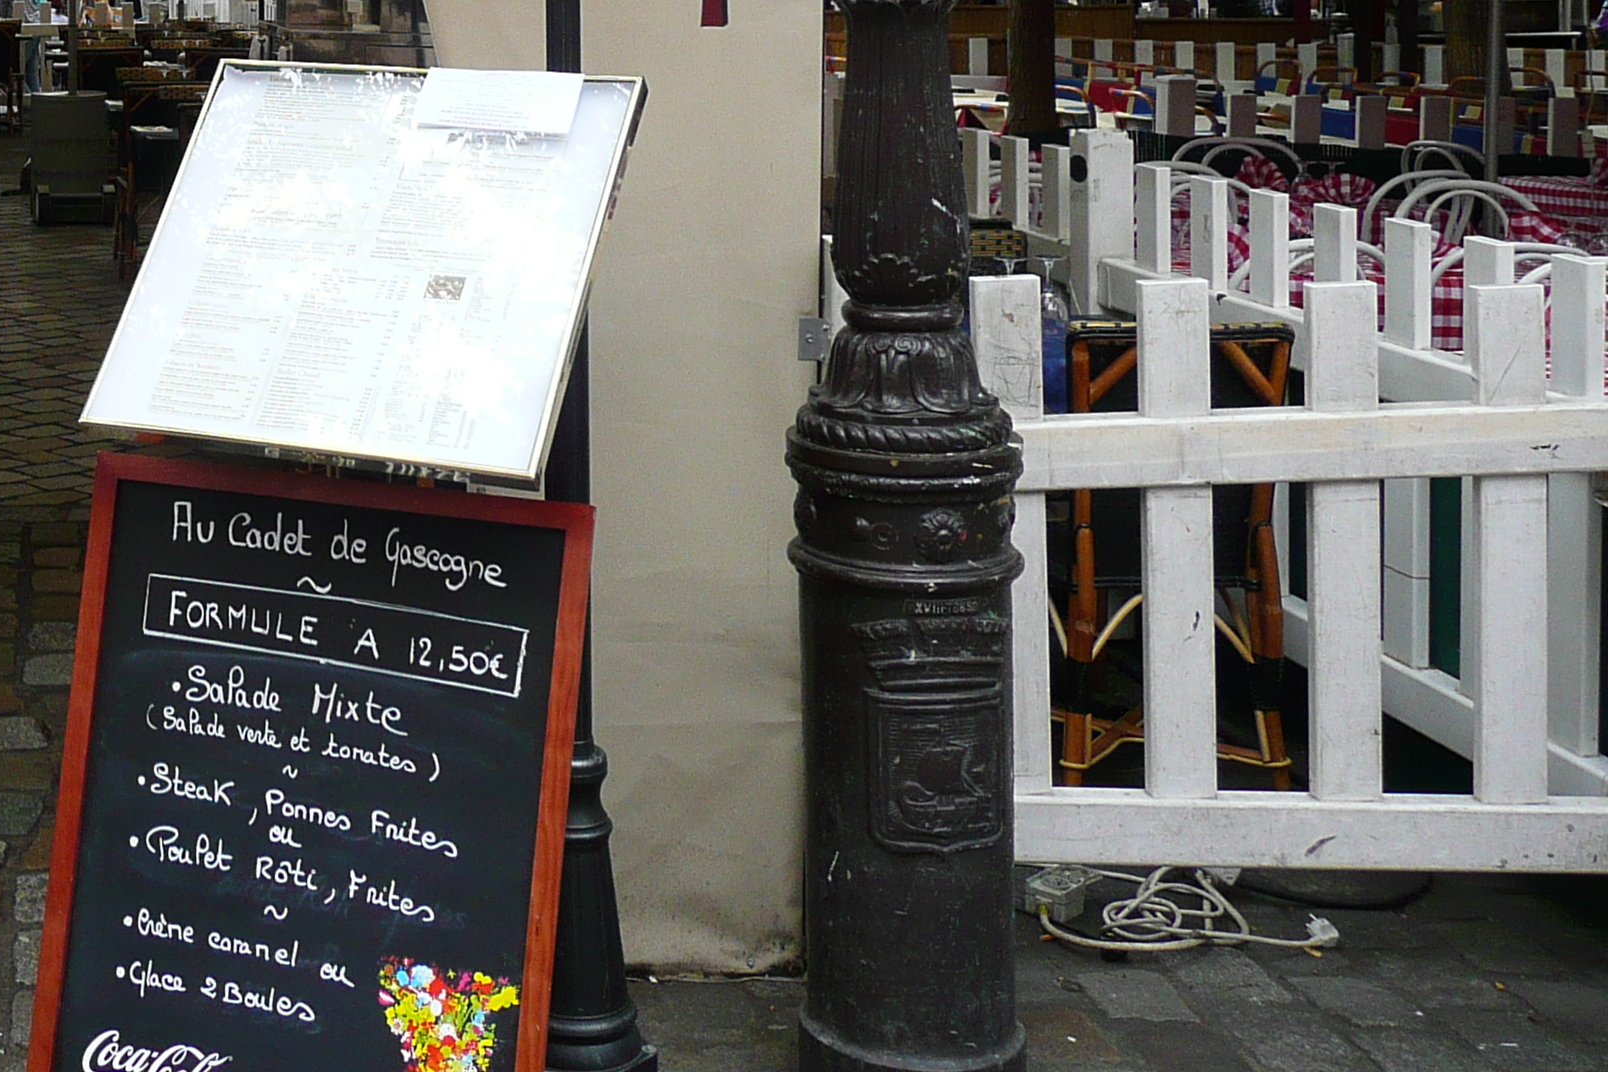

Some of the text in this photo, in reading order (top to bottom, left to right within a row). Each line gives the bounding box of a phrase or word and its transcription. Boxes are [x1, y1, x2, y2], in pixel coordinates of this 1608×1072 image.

[173, 502, 506, 591] Au Cadet de Gascogne
[169, 591, 318, 644] FORMULE
[237, 719, 282, 748] verte
[290, 728, 310, 752] et
[312, 683, 408, 736] Mixte
[269, 825, 302, 848] ou
[371, 810, 458, 857] Frites
[349, 869, 434, 922] Frites
[130, 960, 315, 1021] Glace 2 Boules
[320, 963, 355, 987] ou
